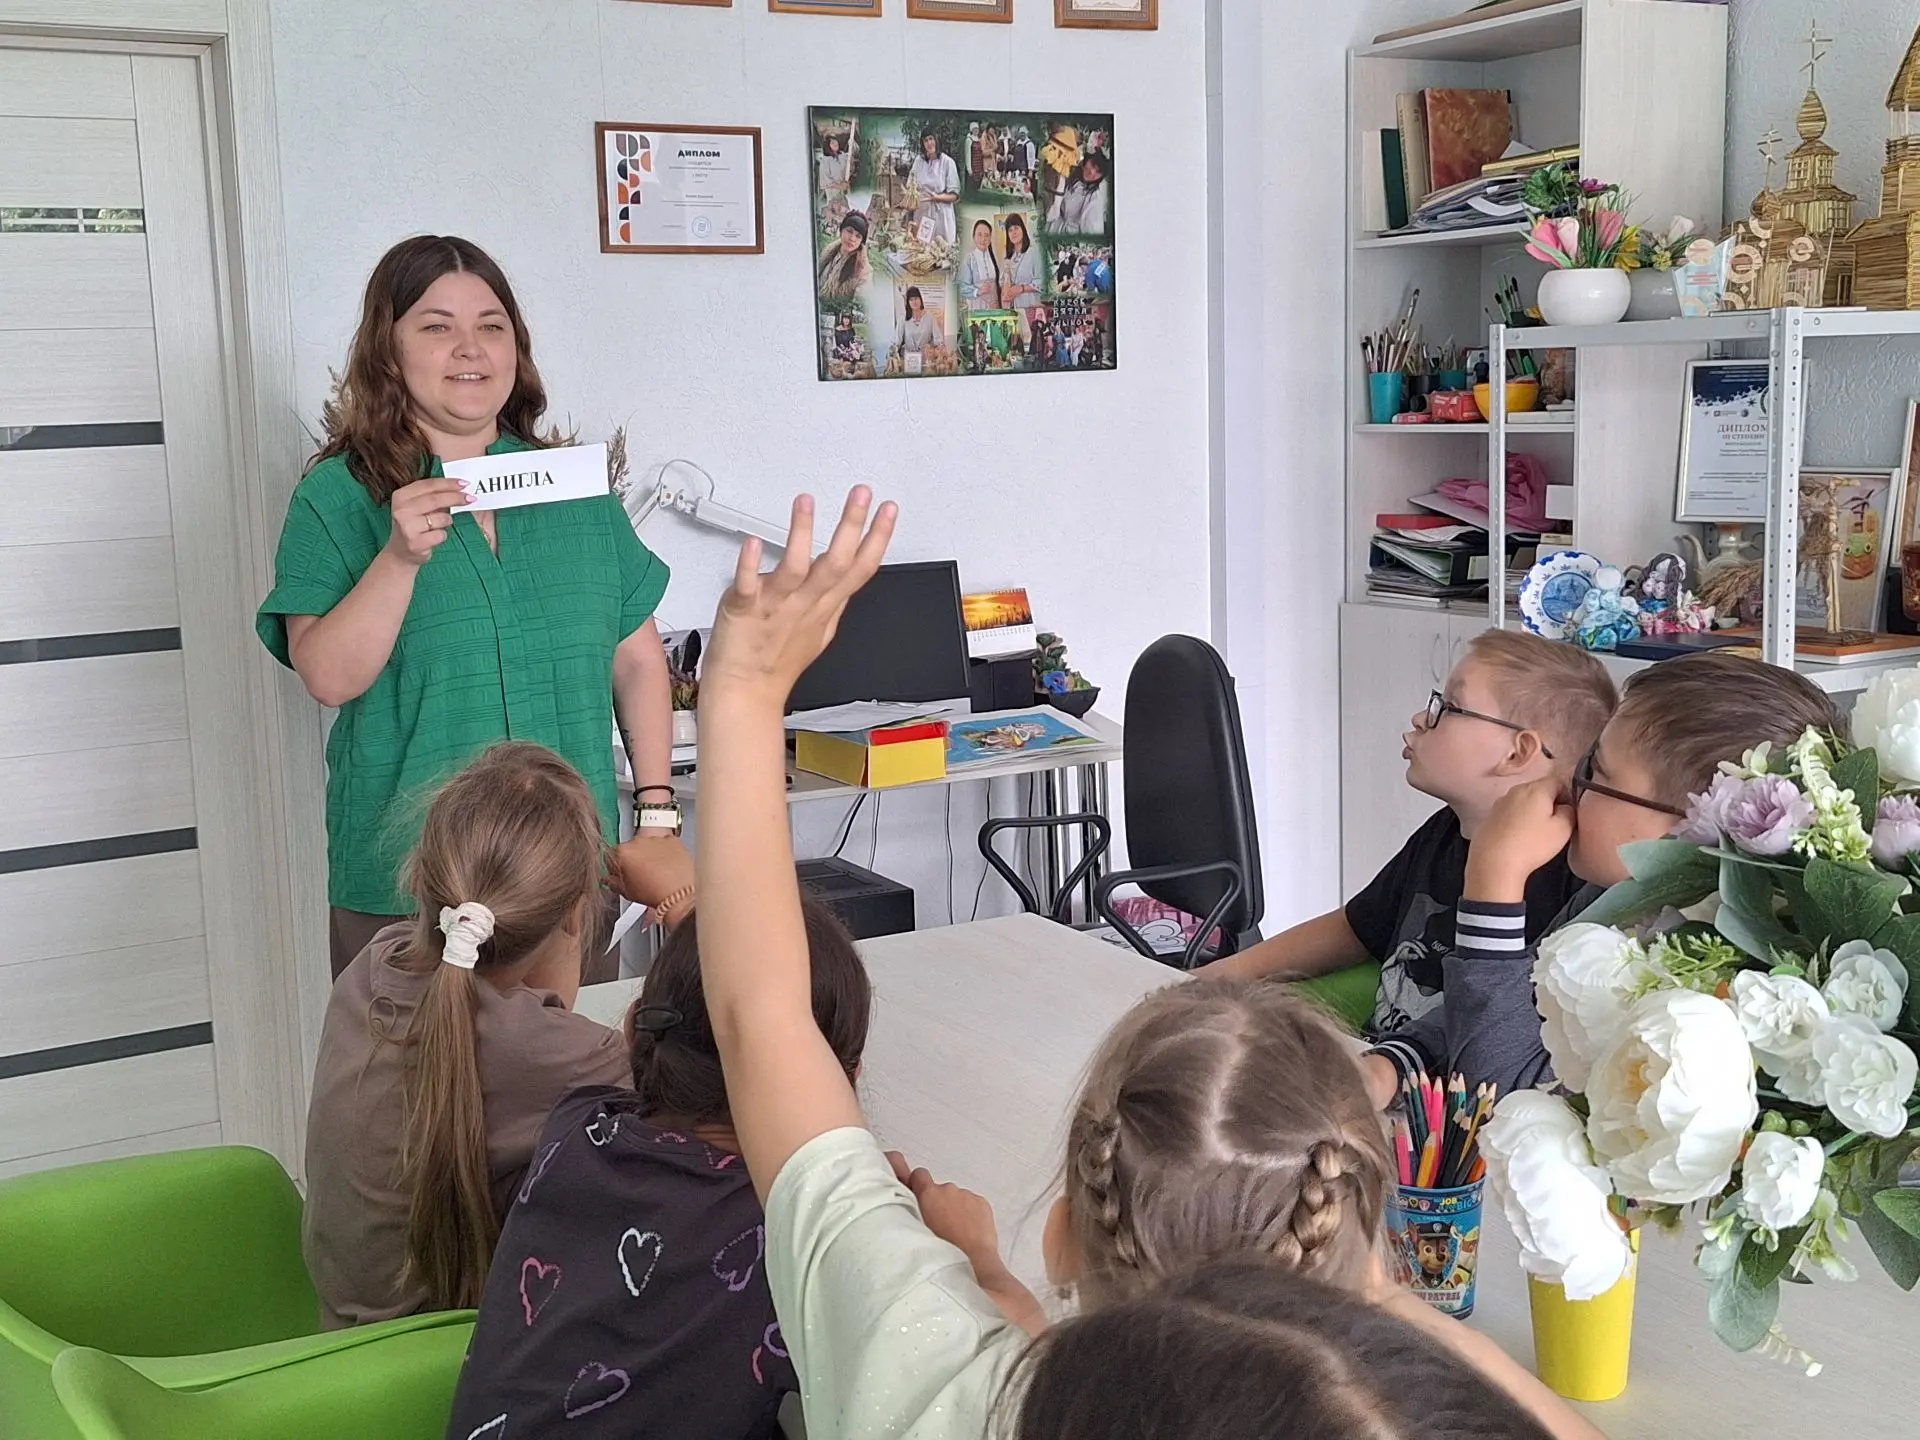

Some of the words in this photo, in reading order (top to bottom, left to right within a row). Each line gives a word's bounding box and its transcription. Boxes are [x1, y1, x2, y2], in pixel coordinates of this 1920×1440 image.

[677, 149, 720, 158] ДИПЛОМ
[1053, 307, 1087, 318] ВЯТКА
[474, 470, 555, 494] АНИГЛА
